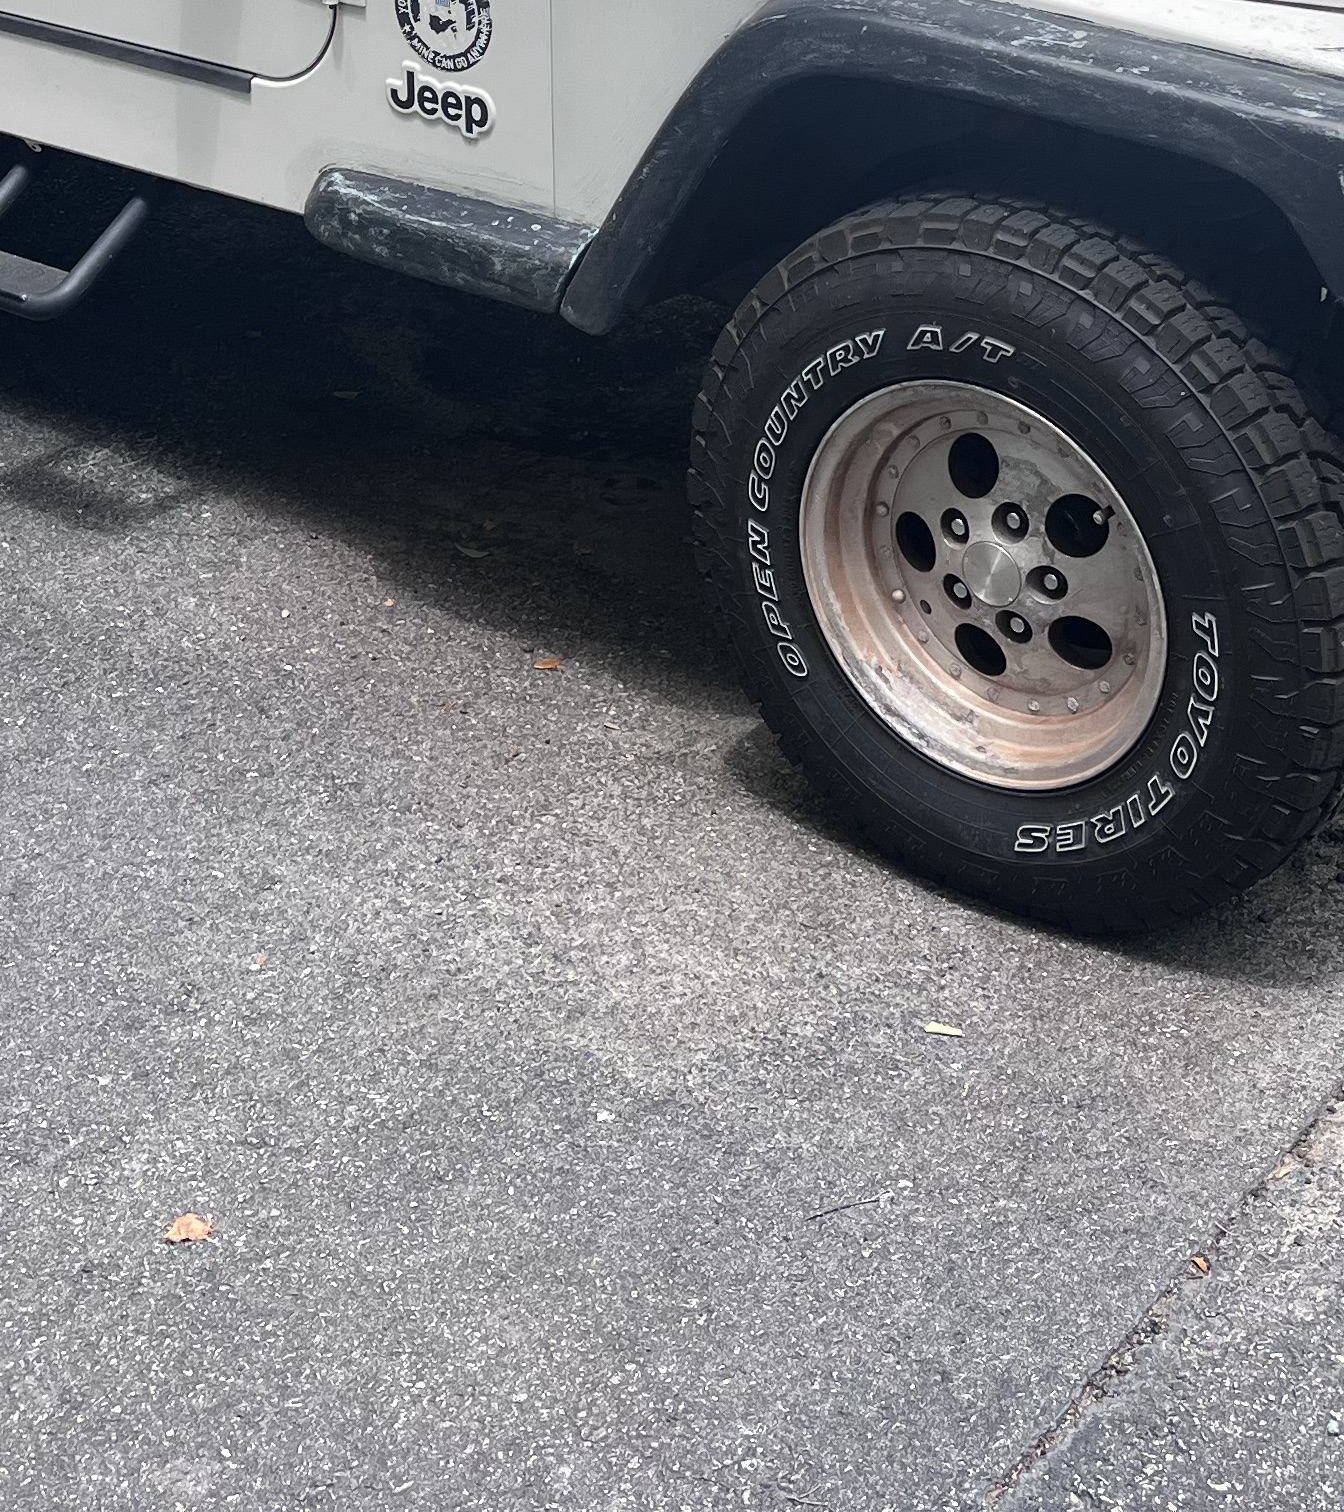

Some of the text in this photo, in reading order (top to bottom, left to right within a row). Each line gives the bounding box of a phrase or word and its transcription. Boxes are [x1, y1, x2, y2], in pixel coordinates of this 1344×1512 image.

[412, 37, 435, 63] MINE
[435, 56, 454, 70] CAN
[456, 56, 468, 69] GO
[390, 70, 490, 134] Jeep
[747, 324, 1016, 678] OPEN COUNTRY A/T
[1012, 773, 1175, 853] TIRES
